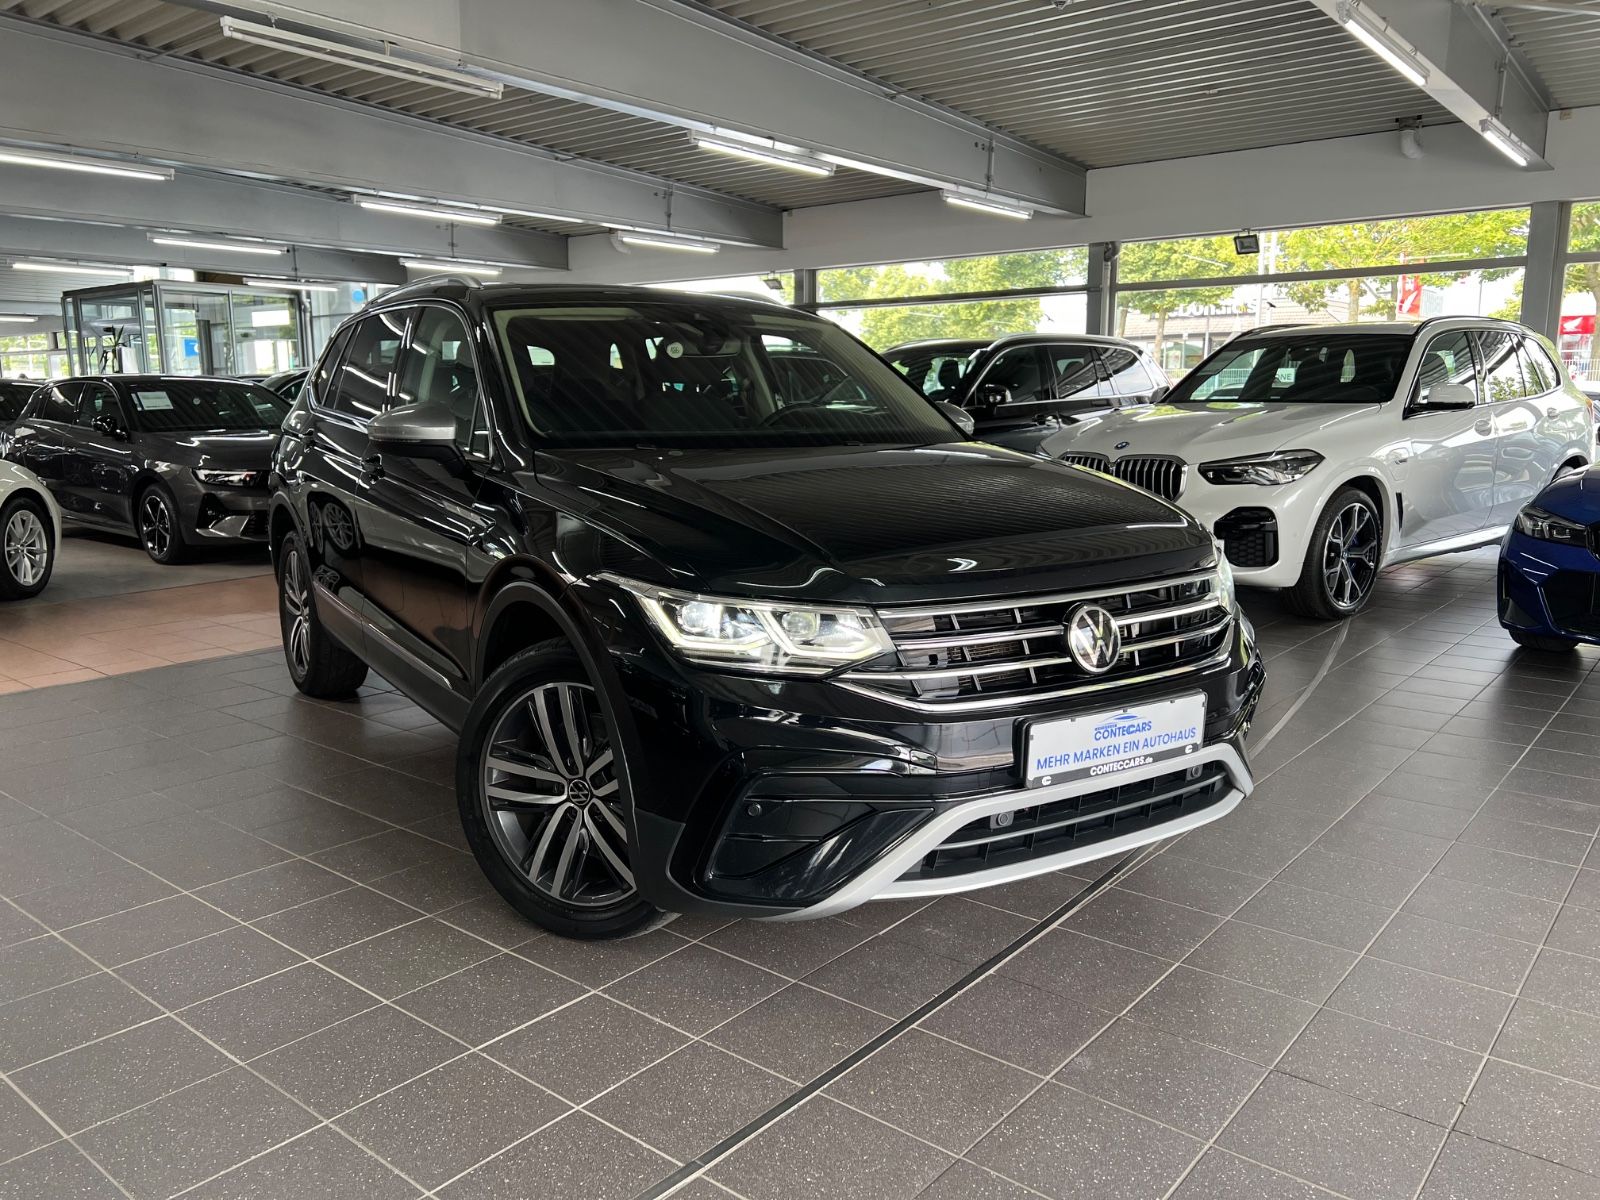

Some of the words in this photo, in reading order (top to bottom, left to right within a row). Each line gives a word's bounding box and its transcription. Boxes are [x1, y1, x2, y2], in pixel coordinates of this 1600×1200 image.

[1036, 753, 1070, 770] MEHR
[1073, 745, 1121, 764] MARKEN
[1123, 740, 1140, 754] EIN
[1141, 727, 1197, 750] AUTOHAUS
[1090, 756, 1154, 776] CONTECCARS.de
